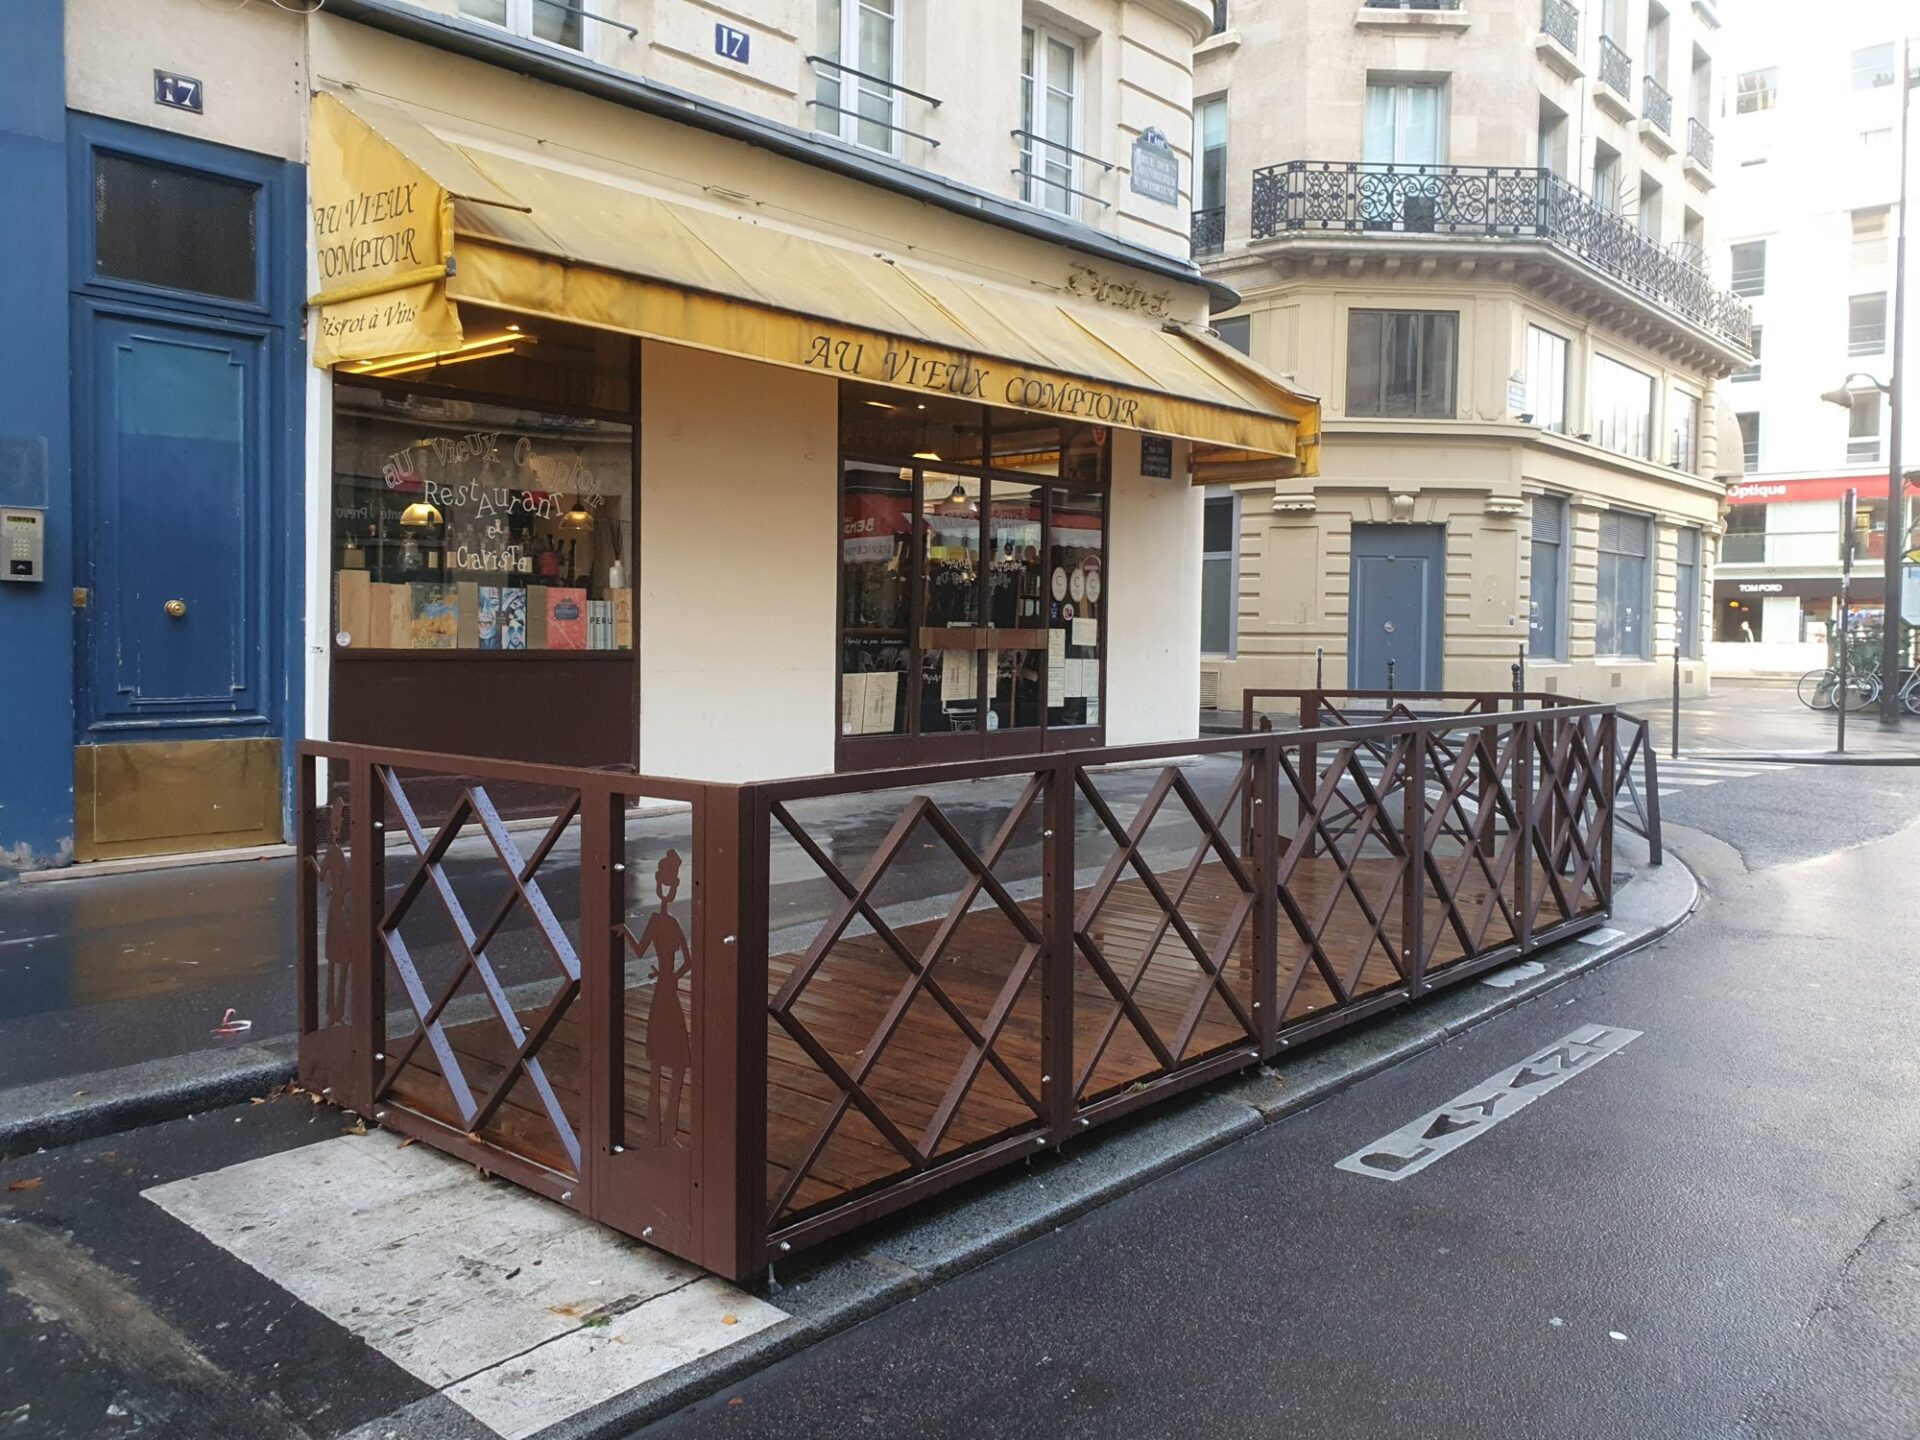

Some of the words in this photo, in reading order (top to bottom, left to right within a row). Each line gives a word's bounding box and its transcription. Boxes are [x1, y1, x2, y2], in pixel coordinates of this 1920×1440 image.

[721, 27, 744, 57] 17
[162, 78, 196, 107] 17
[314, 205, 342, 236] AU
[346, 182, 418, 228] VIEUX
[317, 227, 422, 280] COMPTOIR
[368, 307, 379, 331] à
[384, 301, 418, 328] Vins
[804, 335, 864, 375] AU
[884, 350, 990, 399] VIEUX
[1005, 376, 1140, 426] COMPTOIR
[1727, 484, 1787, 499] Optique
[487, 519, 504, 539] et
[1739, 583, 1758, 592] TOM
[1759, 583, 1783, 592] FORD
[590, 616, 614, 625] PERU
[1360, 1030, 1613, 1173] PAYANT
